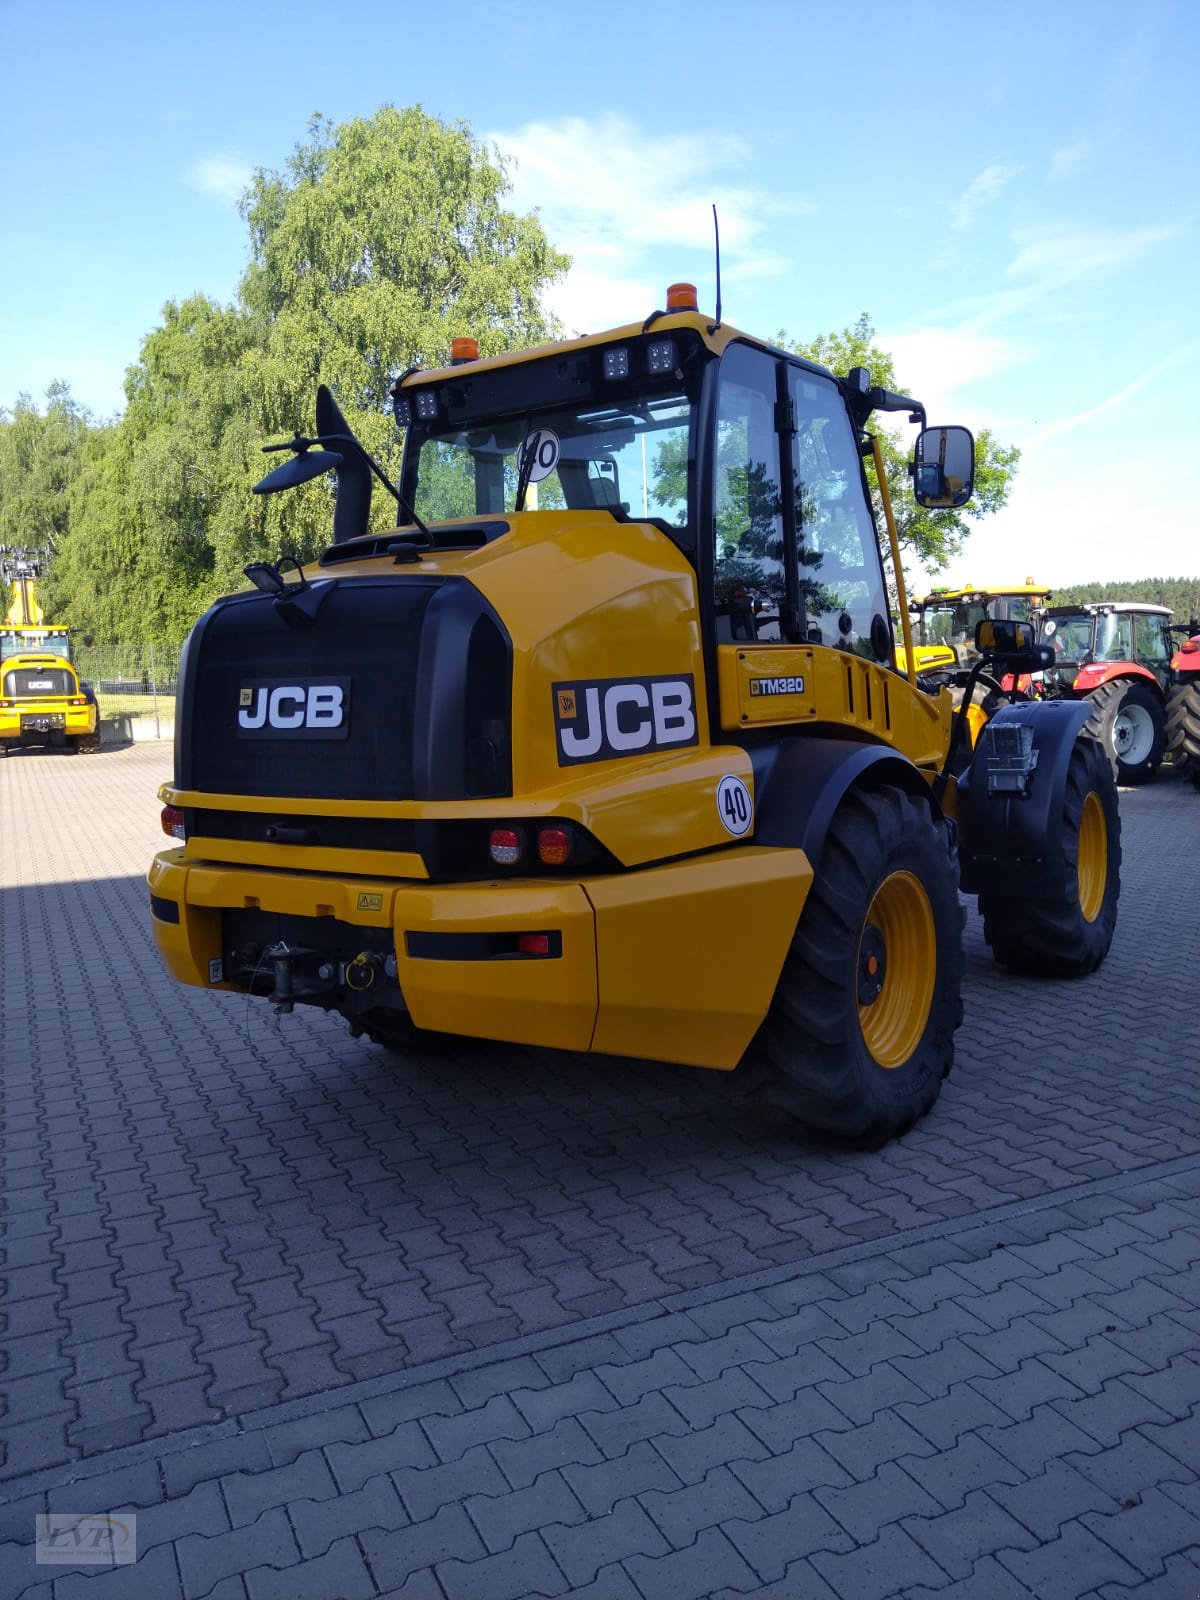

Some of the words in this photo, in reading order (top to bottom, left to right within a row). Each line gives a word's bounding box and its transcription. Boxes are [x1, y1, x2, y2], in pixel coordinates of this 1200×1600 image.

[760, 678, 803, 694] TM320
[239, 686, 343, 728] JCB
[560, 681, 695, 757] JCB
[725, 787, 747, 824] 40
